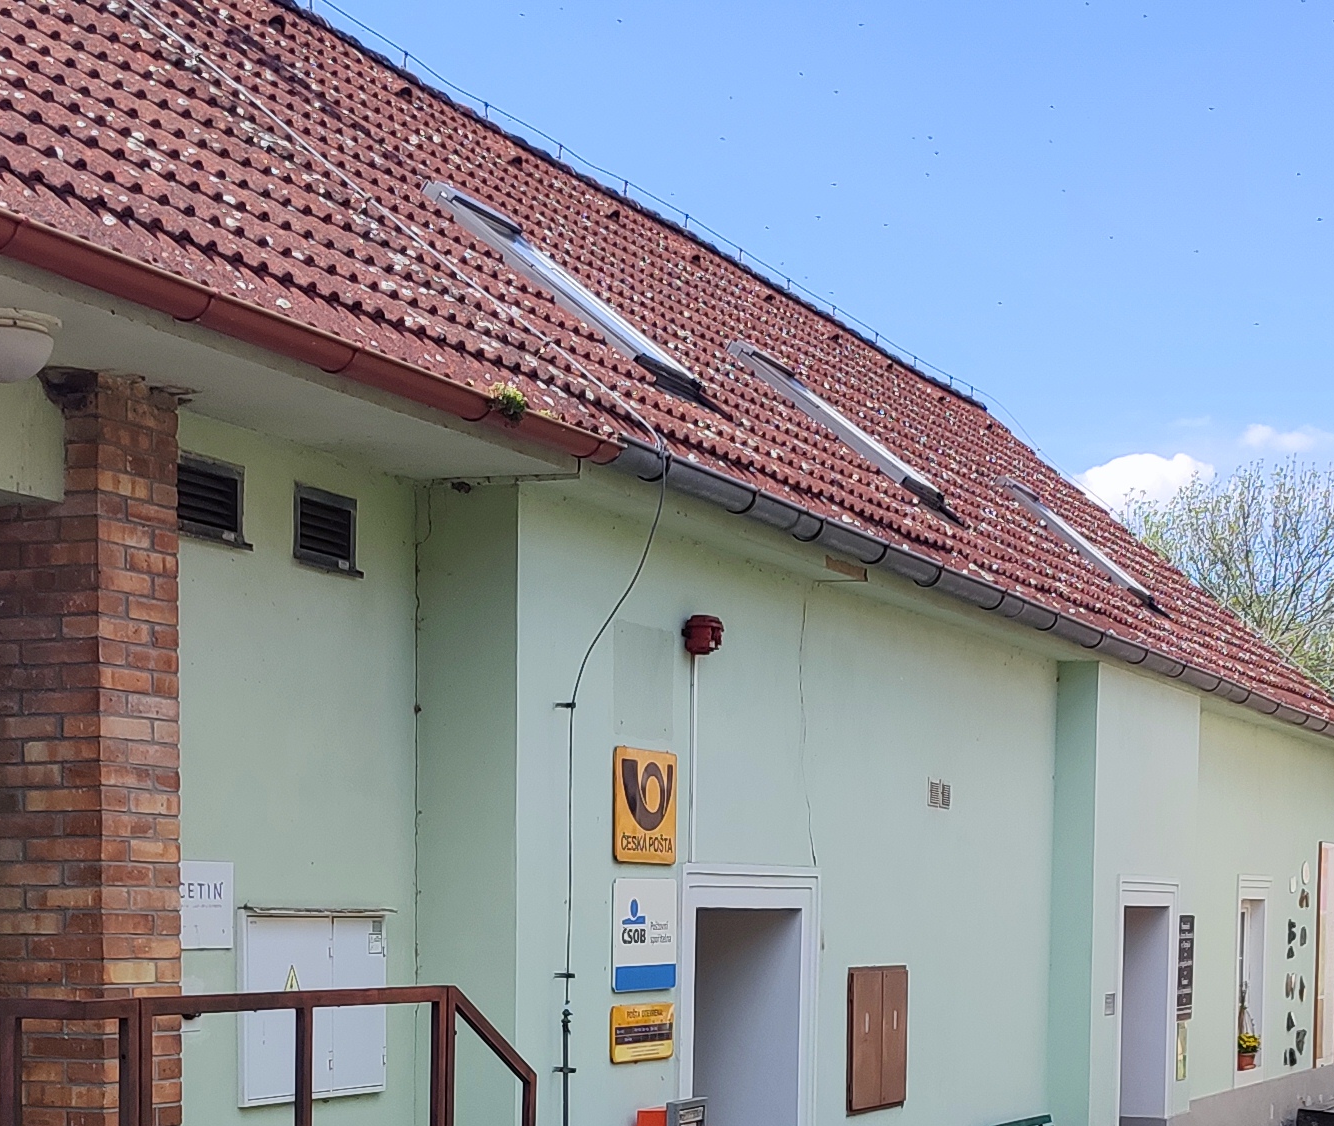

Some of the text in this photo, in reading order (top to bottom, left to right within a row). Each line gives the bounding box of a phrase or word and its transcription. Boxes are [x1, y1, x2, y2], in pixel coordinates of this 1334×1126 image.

[620, 831, 673, 853] ČESKÁ POŠTA
[622, 926, 646, 944] ČSOB
